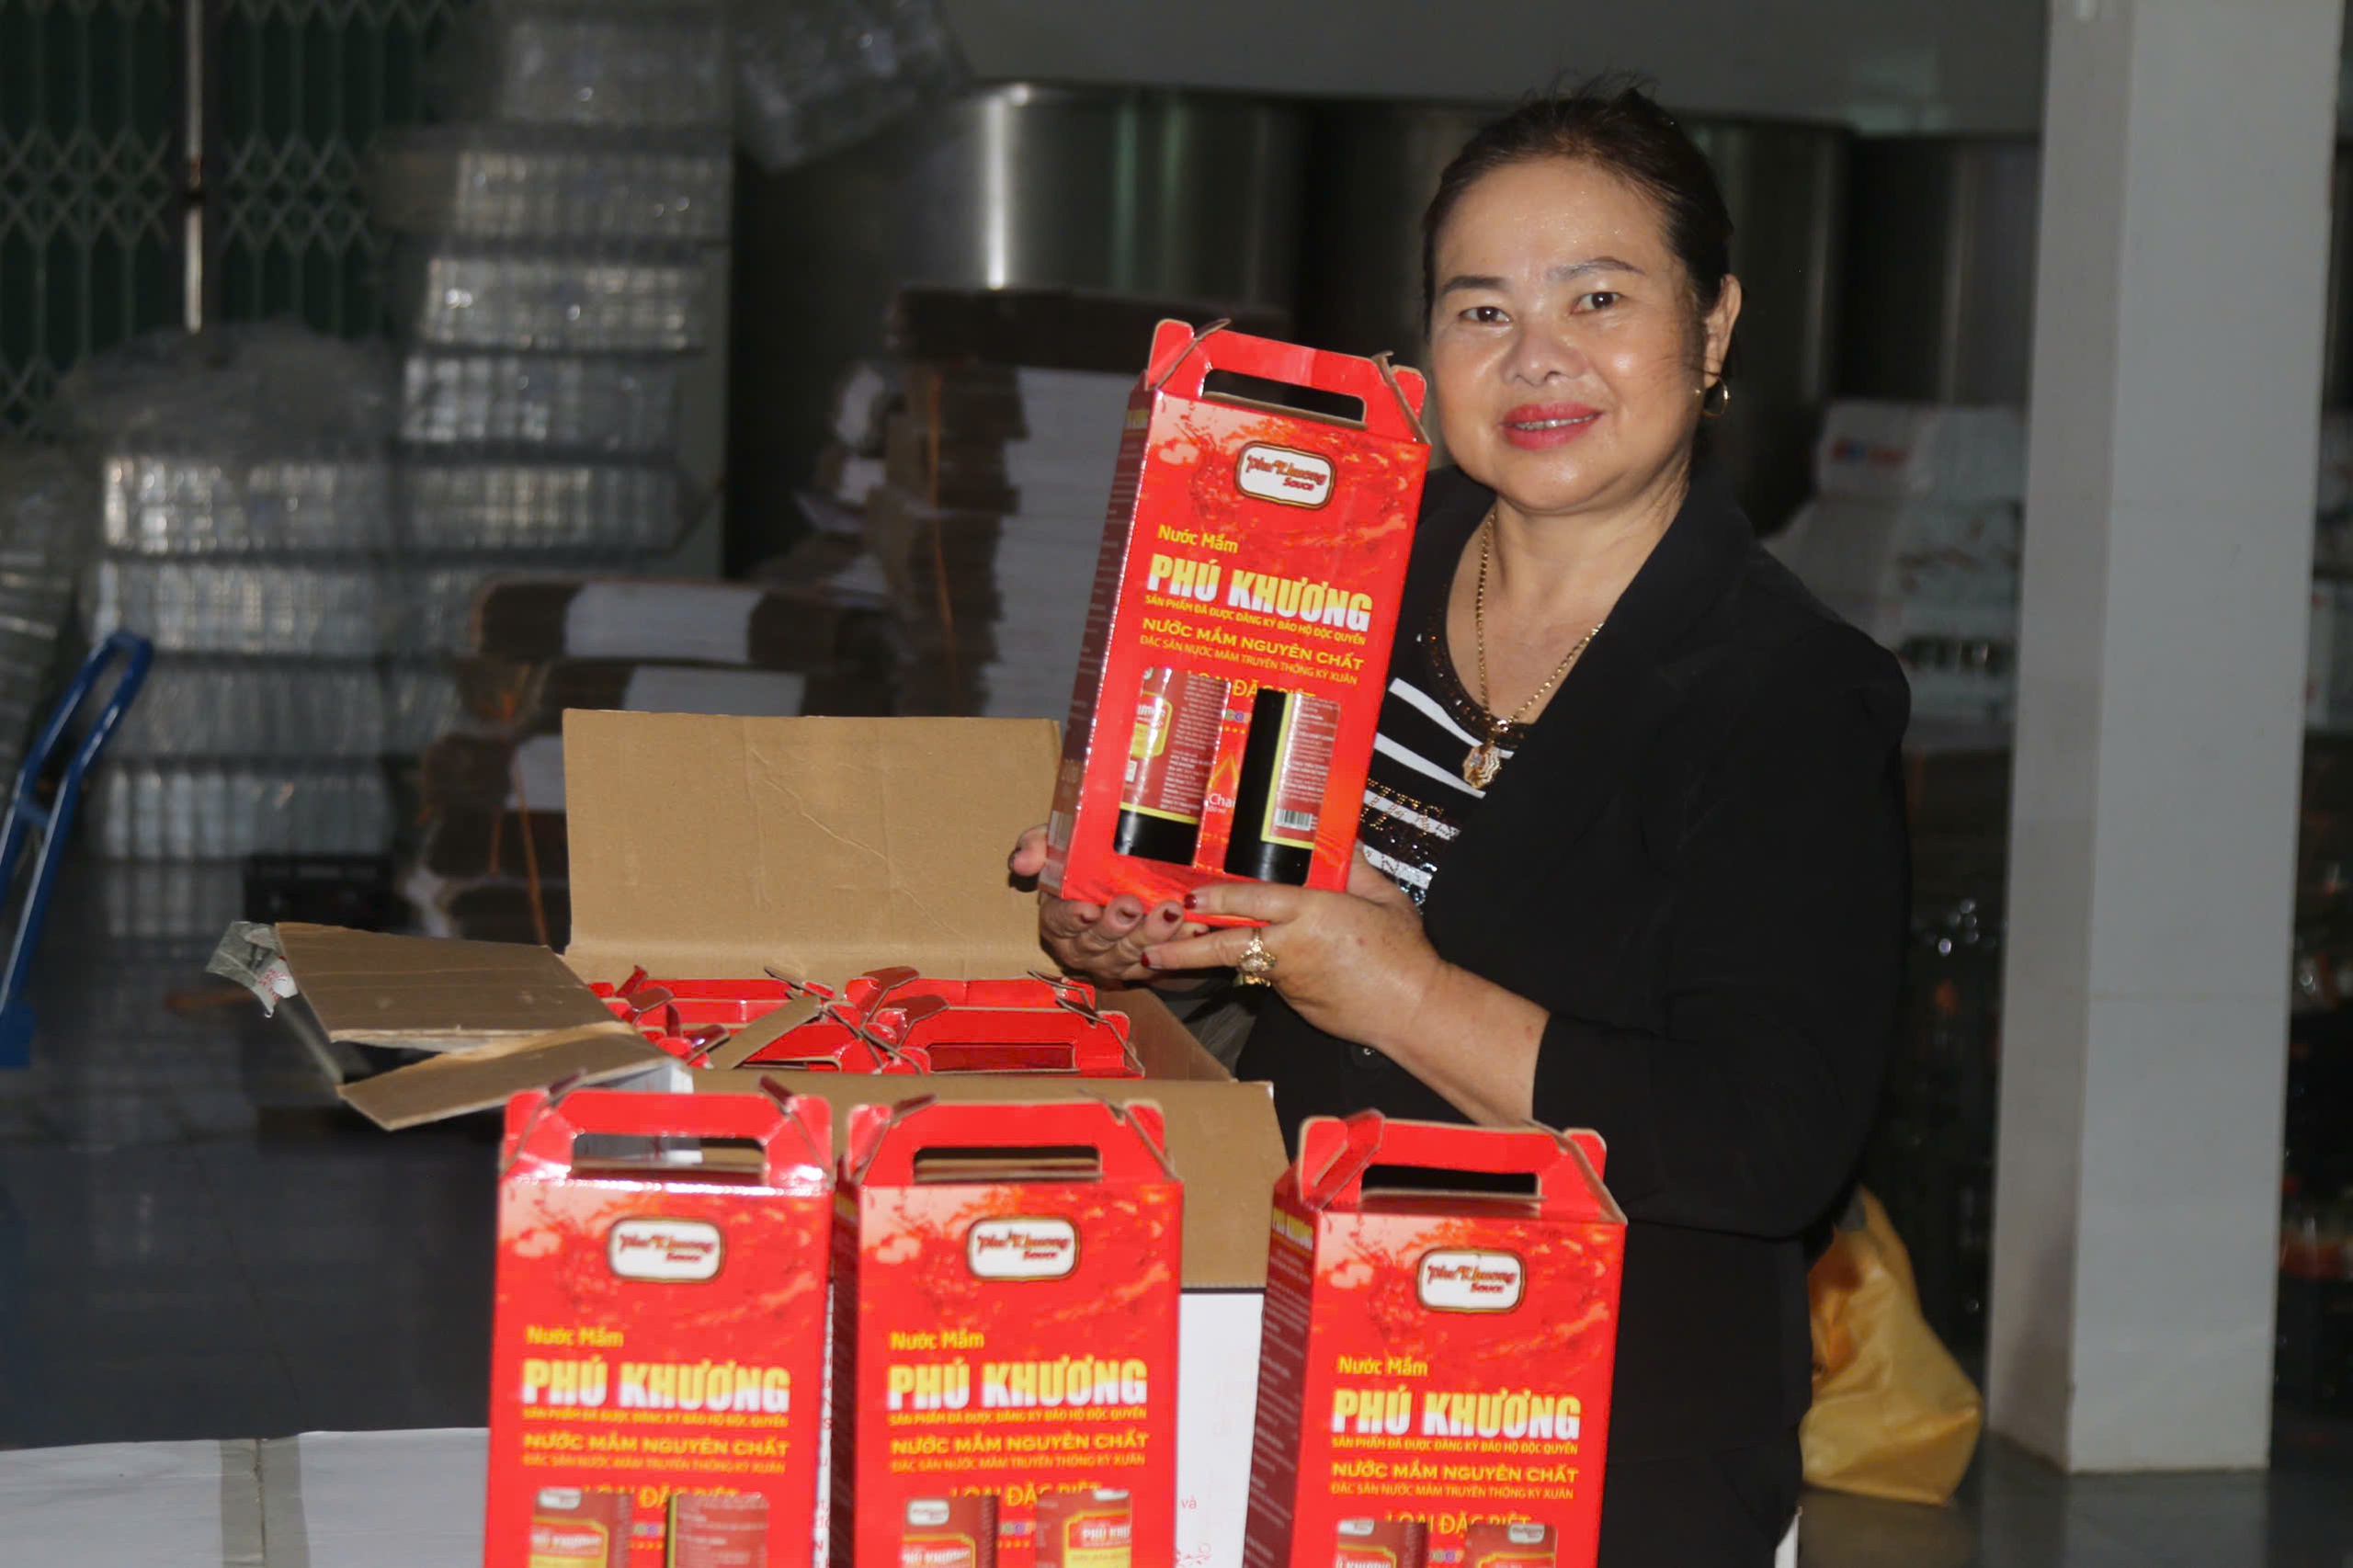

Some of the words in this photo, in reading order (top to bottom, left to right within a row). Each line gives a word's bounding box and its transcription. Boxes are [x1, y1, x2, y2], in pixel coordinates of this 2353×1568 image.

[1158, 523, 1198, 546] Nước
[1201, 531, 1239, 554] Mắm
[1146, 552, 1222, 602] PHÚ
[1227, 568, 1374, 632] KHƯƠNG
[1142, 617, 1193, 637] NƯỚC
[1241, 636, 1313, 661] NGUYÊN
[1316, 652, 1365, 670] CHẤT
[526, 1325, 574, 1346] Nước
[578, 1324, 624, 1348] Mắm
[890, 1330, 937, 1350] Nước
[940, 1327, 984, 1349] Mắm
[1338, 1355, 1382, 1375] Nước
[1387, 1355, 1428, 1377] Mắm
[521, 1355, 608, 1408] PHÚ
[619, 1359, 791, 1415] KHƯƠNG
[887, 1356, 971, 1411] PHÚ
[982, 1354, 1148, 1408] KHƯƠNG
[1331, 1383, 1413, 1435] PHÚ
[1423, 1386, 1582, 1440] KHƯƠNG
[523, 1430, 584, 1450] NƯỚC
[642, 1435, 729, 1455] NGUYÊN
[733, 1434, 790, 1458] CHẤT
[891, 1434, 949, 1455] NƯỚC
[1006, 1430, 1090, 1451] NGUYÊN
[1094, 1426, 1149, 1449] CHẤT
[1331, 1459, 1389, 1478] NƯỚC
[1443, 1462, 1522, 1482] NGUYÊN
[1527, 1462, 1579, 1483] CHẤT
